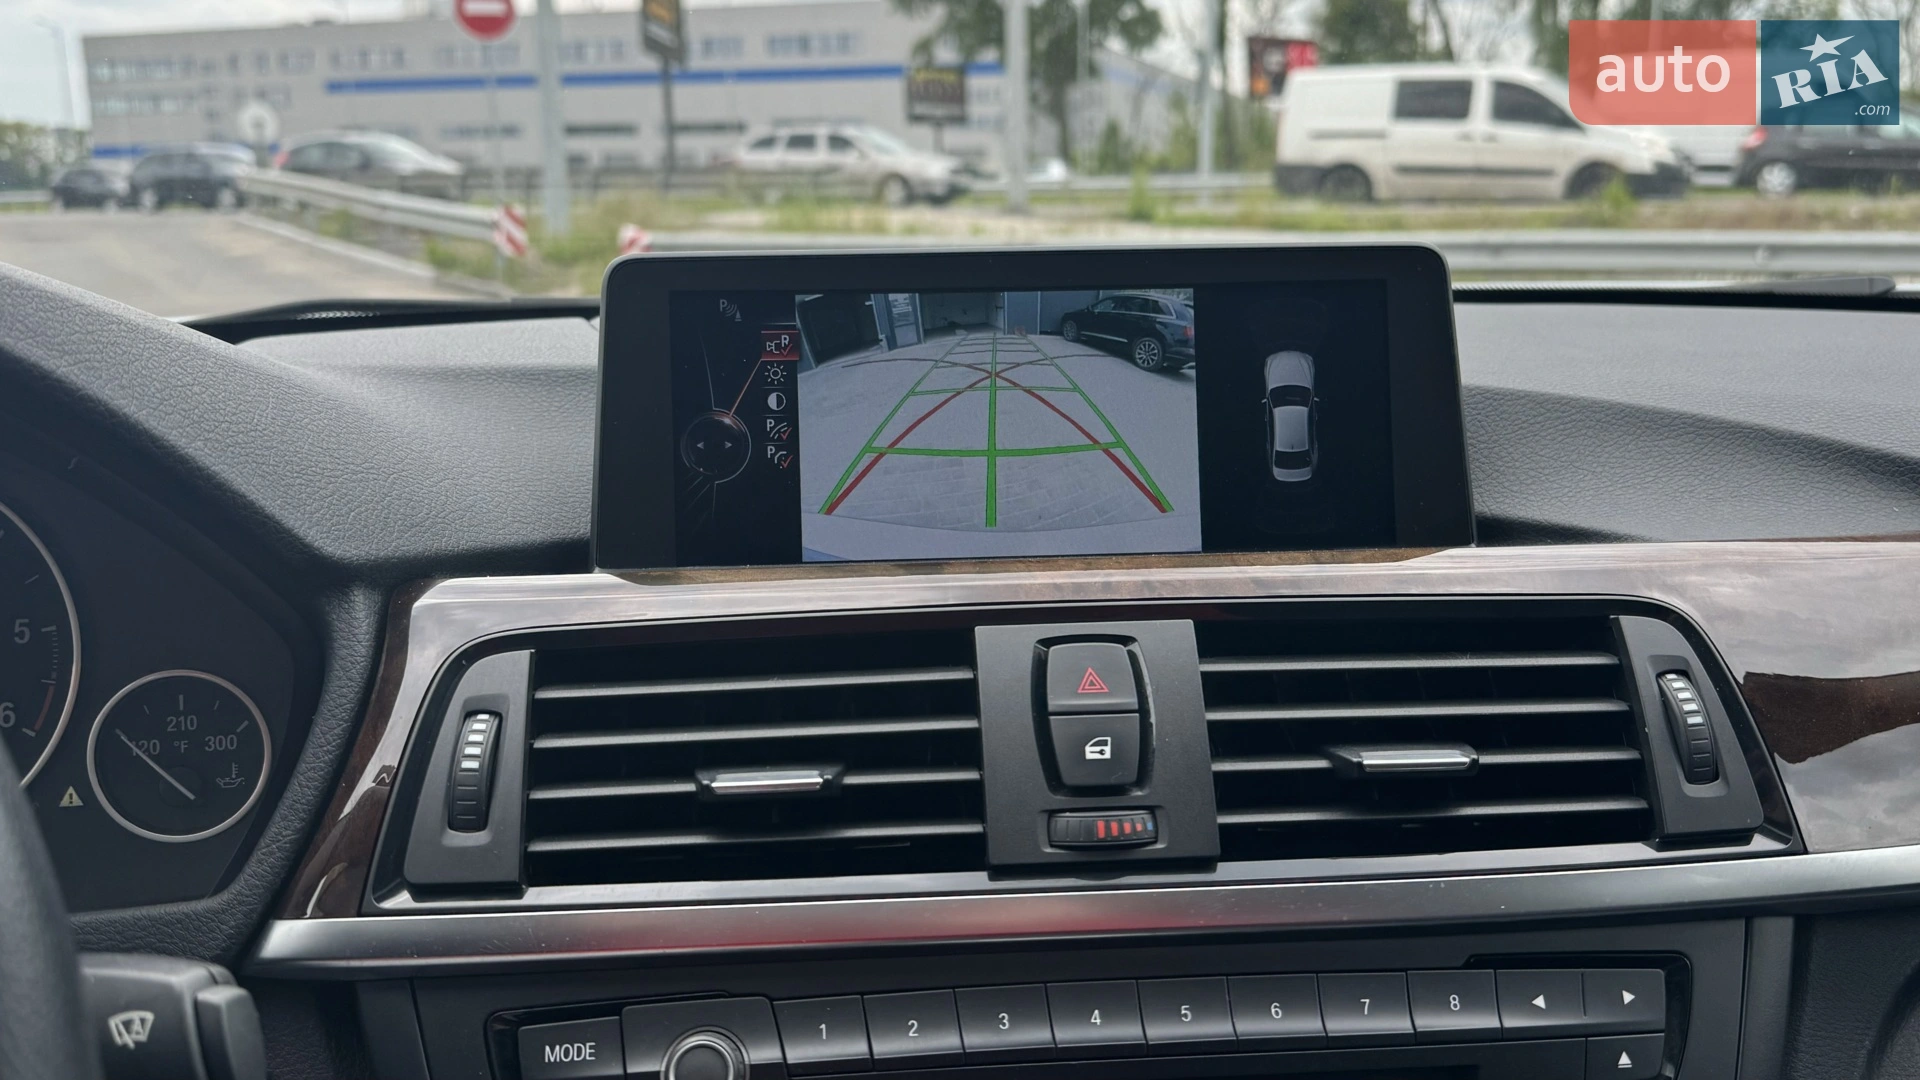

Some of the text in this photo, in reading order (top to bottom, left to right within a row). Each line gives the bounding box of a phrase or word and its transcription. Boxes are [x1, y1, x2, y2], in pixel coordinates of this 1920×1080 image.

[14, 618, 31, 644] 5
[0, 702, 16, 728] 6
[166, 715, 198, 732] 210
[173, 740, 189, 754] °F
[204, 734, 238, 752] 300
[1270, 1002, 1282, 1020] 6
[1360, 999, 1371, 1016] 7
[1449, 995, 1461, 1012] 8
[998, 1013, 1010, 1031] 3
[1090, 1008, 1102, 1027] 4
[1180, 1005, 1192, 1022] 5
[818, 1023, 828, 1041] 1
[908, 1020, 919, 1038] 2
[543, 1042, 597, 1064] MODE
